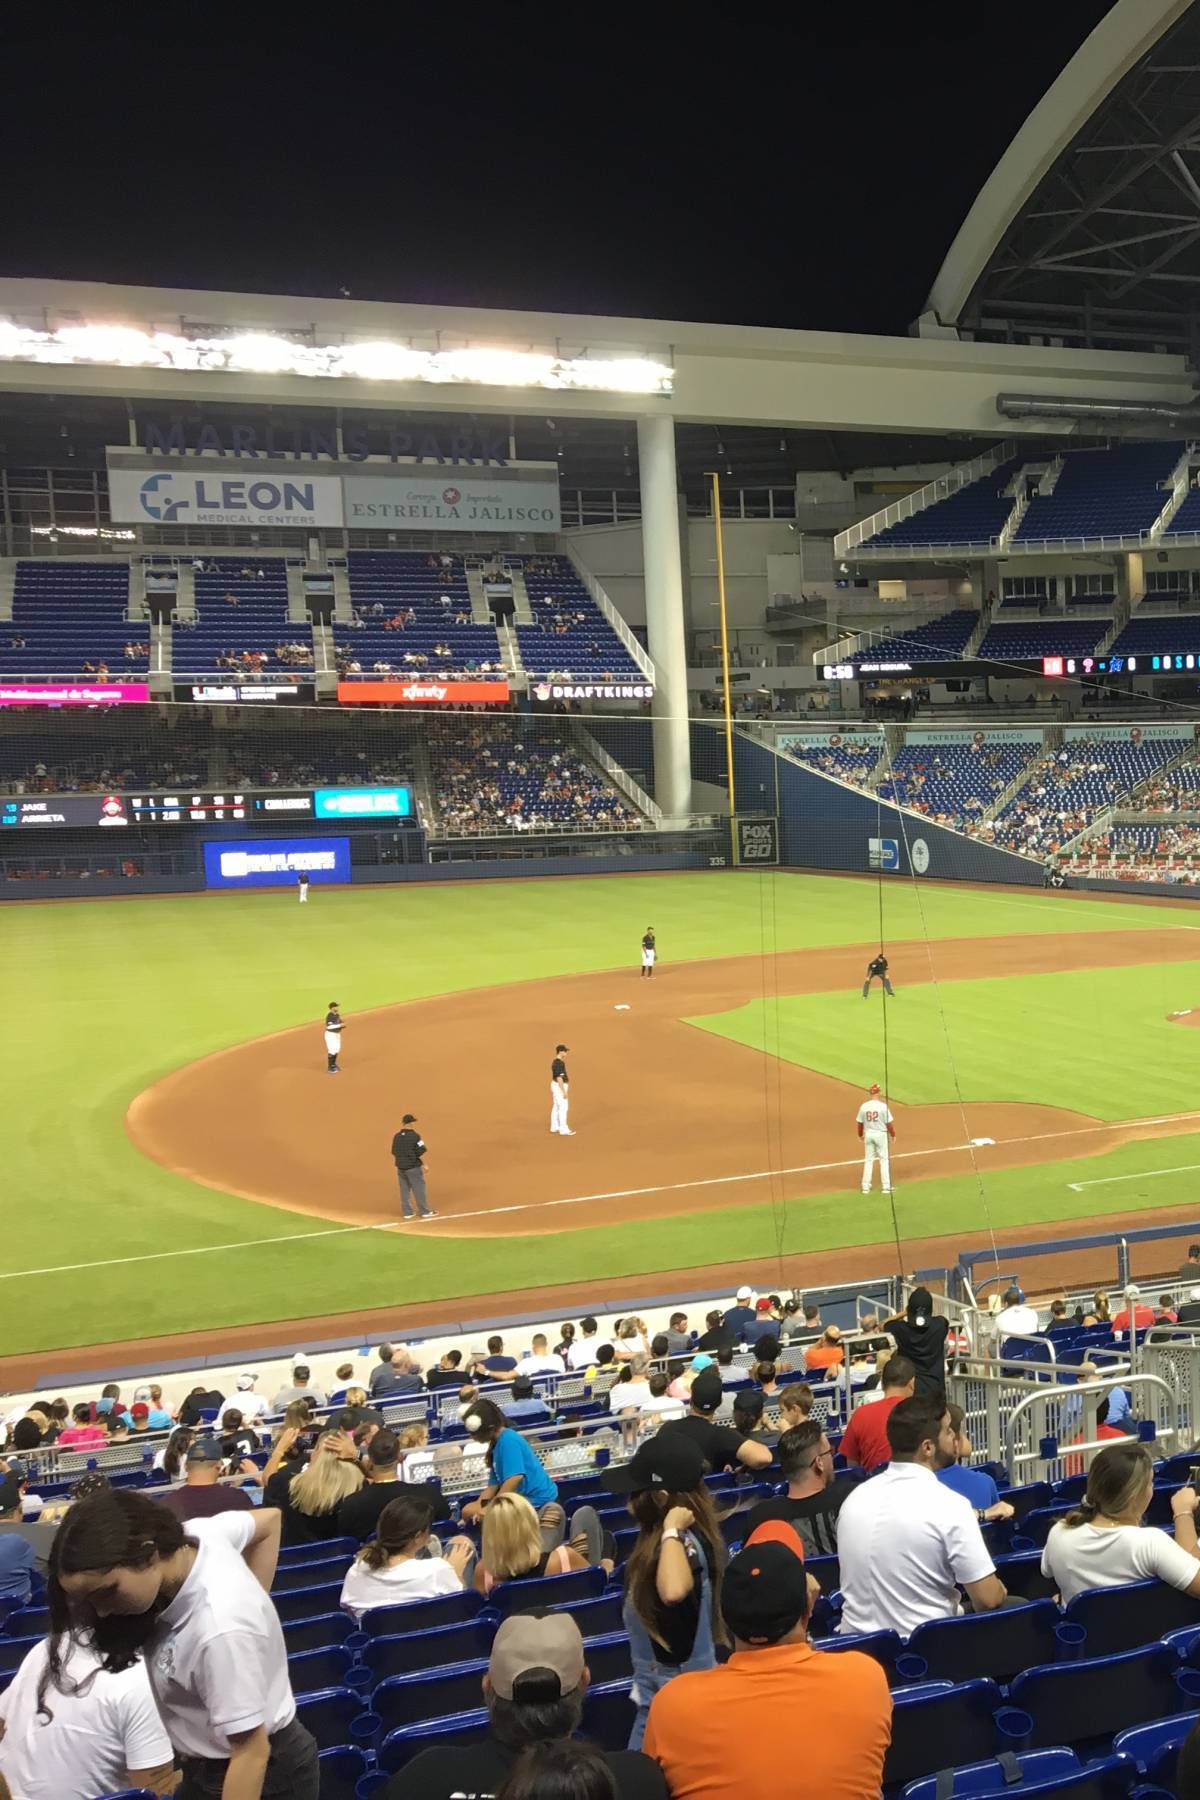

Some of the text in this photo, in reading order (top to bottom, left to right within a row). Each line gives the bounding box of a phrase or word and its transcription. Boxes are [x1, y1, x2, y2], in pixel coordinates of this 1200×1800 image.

[144, 422, 509, 466] MARLINS PARK
[195, 480, 315, 511] LEON
[352, 503, 555, 522] ESTRELLA JALISCO
[197, 514, 315, 525] MEDICAL CENTERS
[402, 685, 447, 700] xfinity
[552, 685, 653, 699] DRAFTKINGS
[986, 732, 1024, 740] JALISCO
[21, 803, 47, 811] JAKE
[134, 812, 140, 821] 1
[150, 811, 156, 820] 1
[742, 825, 772, 838] FOX
[744, 844, 772, 857] GO
[709, 857, 726, 866] 335
[865, 1111, 879, 1122] 62
